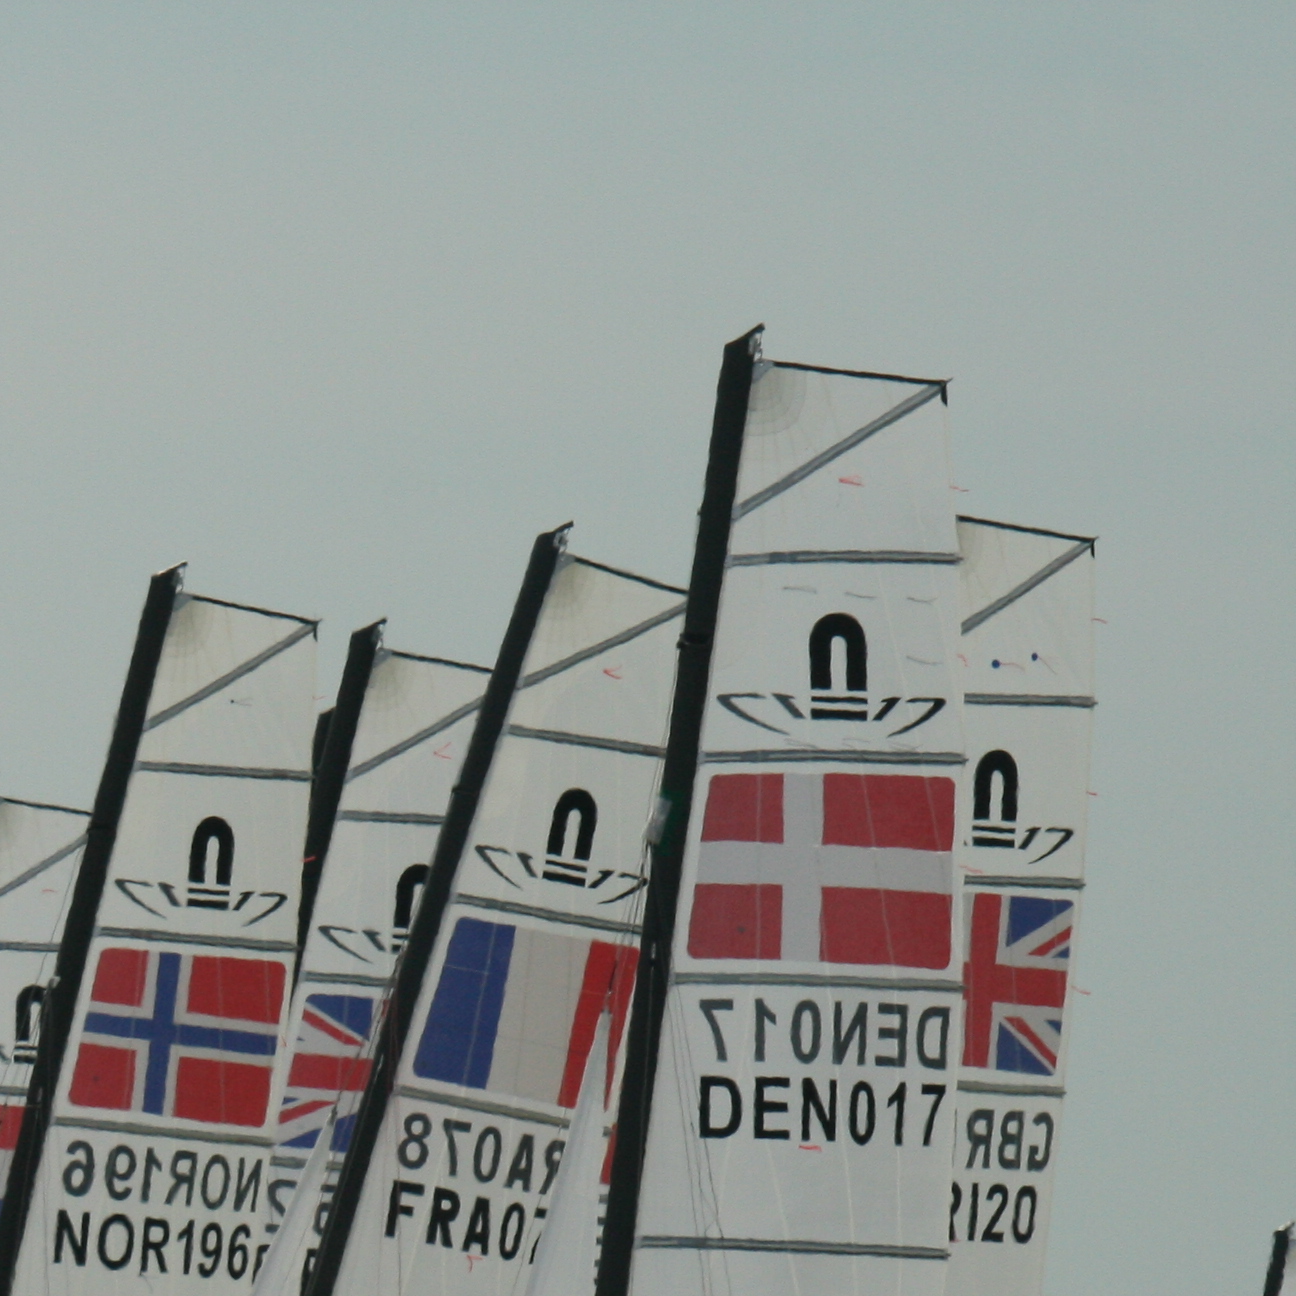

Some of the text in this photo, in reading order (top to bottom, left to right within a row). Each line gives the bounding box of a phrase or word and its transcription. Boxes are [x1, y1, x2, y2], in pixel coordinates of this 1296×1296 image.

[699, 1076, 946, 1146] DEN017
[53, 1209, 249, 1281] NOR196
[385, 1179, 548, 1265] FRA07
